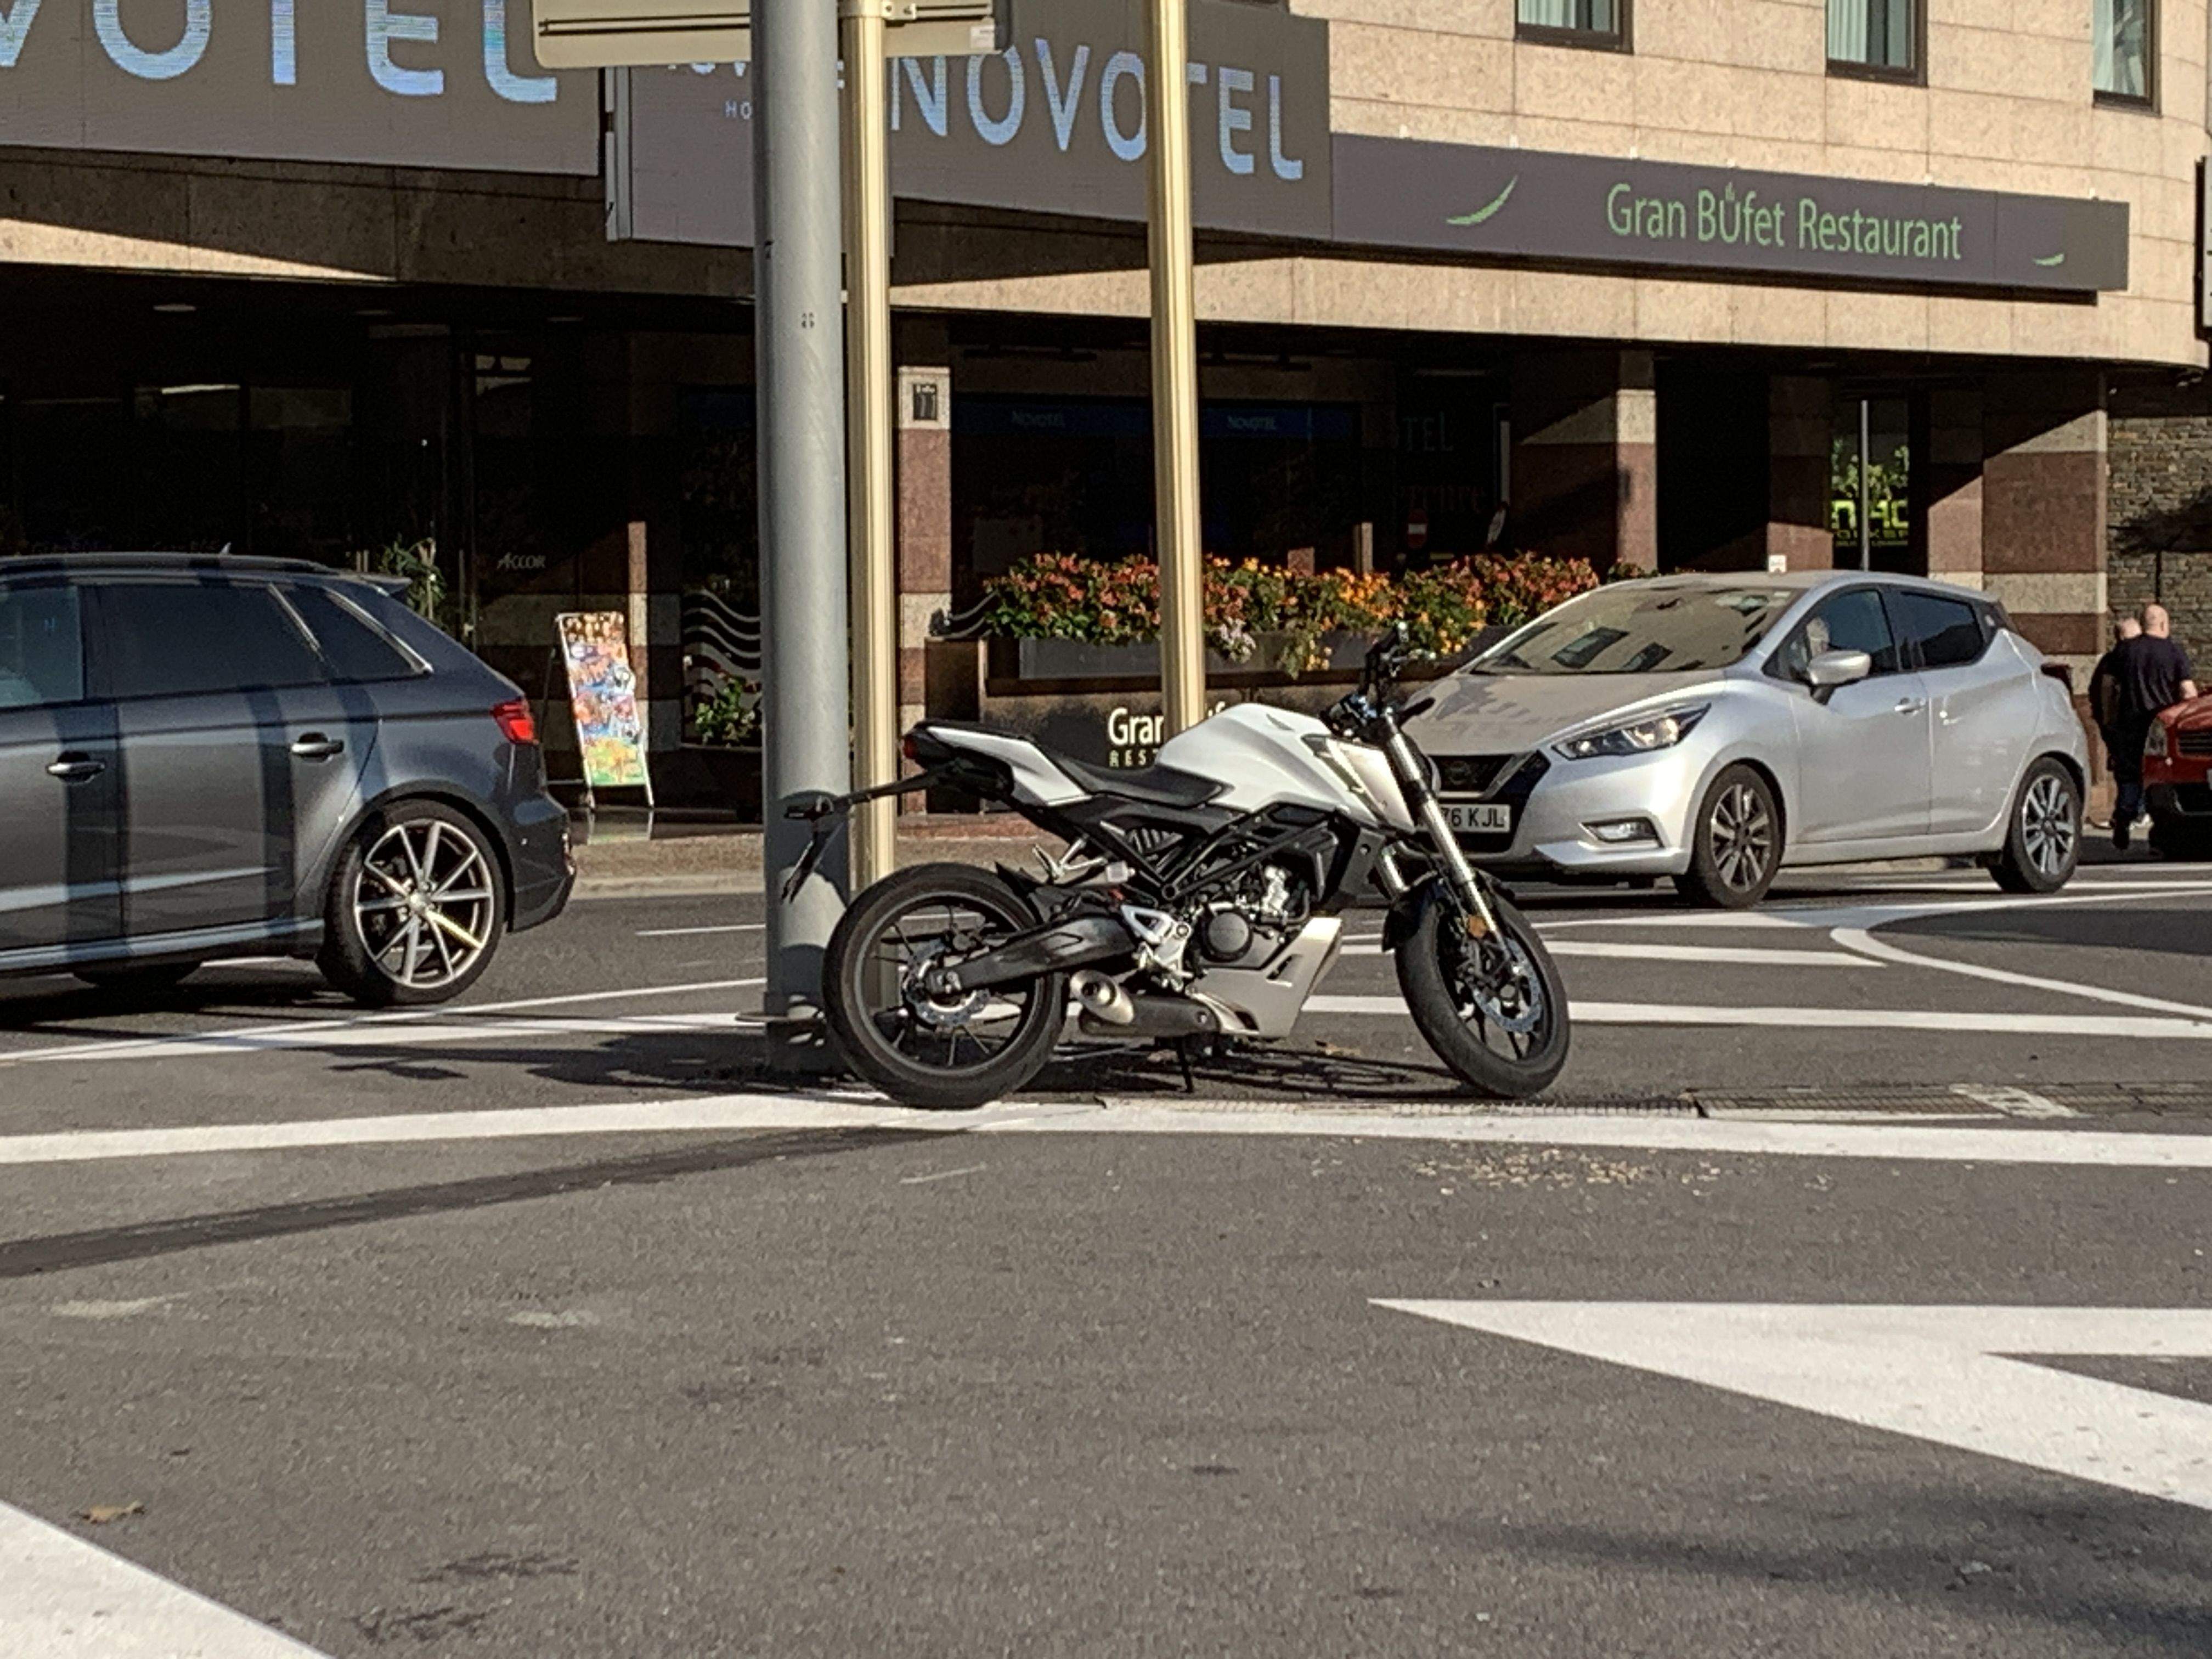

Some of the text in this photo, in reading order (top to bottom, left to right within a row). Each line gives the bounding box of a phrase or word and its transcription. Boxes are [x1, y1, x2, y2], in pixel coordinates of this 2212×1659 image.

[891, 38, 1303, 179] NOVOEL
[1607, 183, 1686, 238] Gran
[1799, 198, 1962, 260] Restaurant
[1468, 808, 1504, 828] KJL
